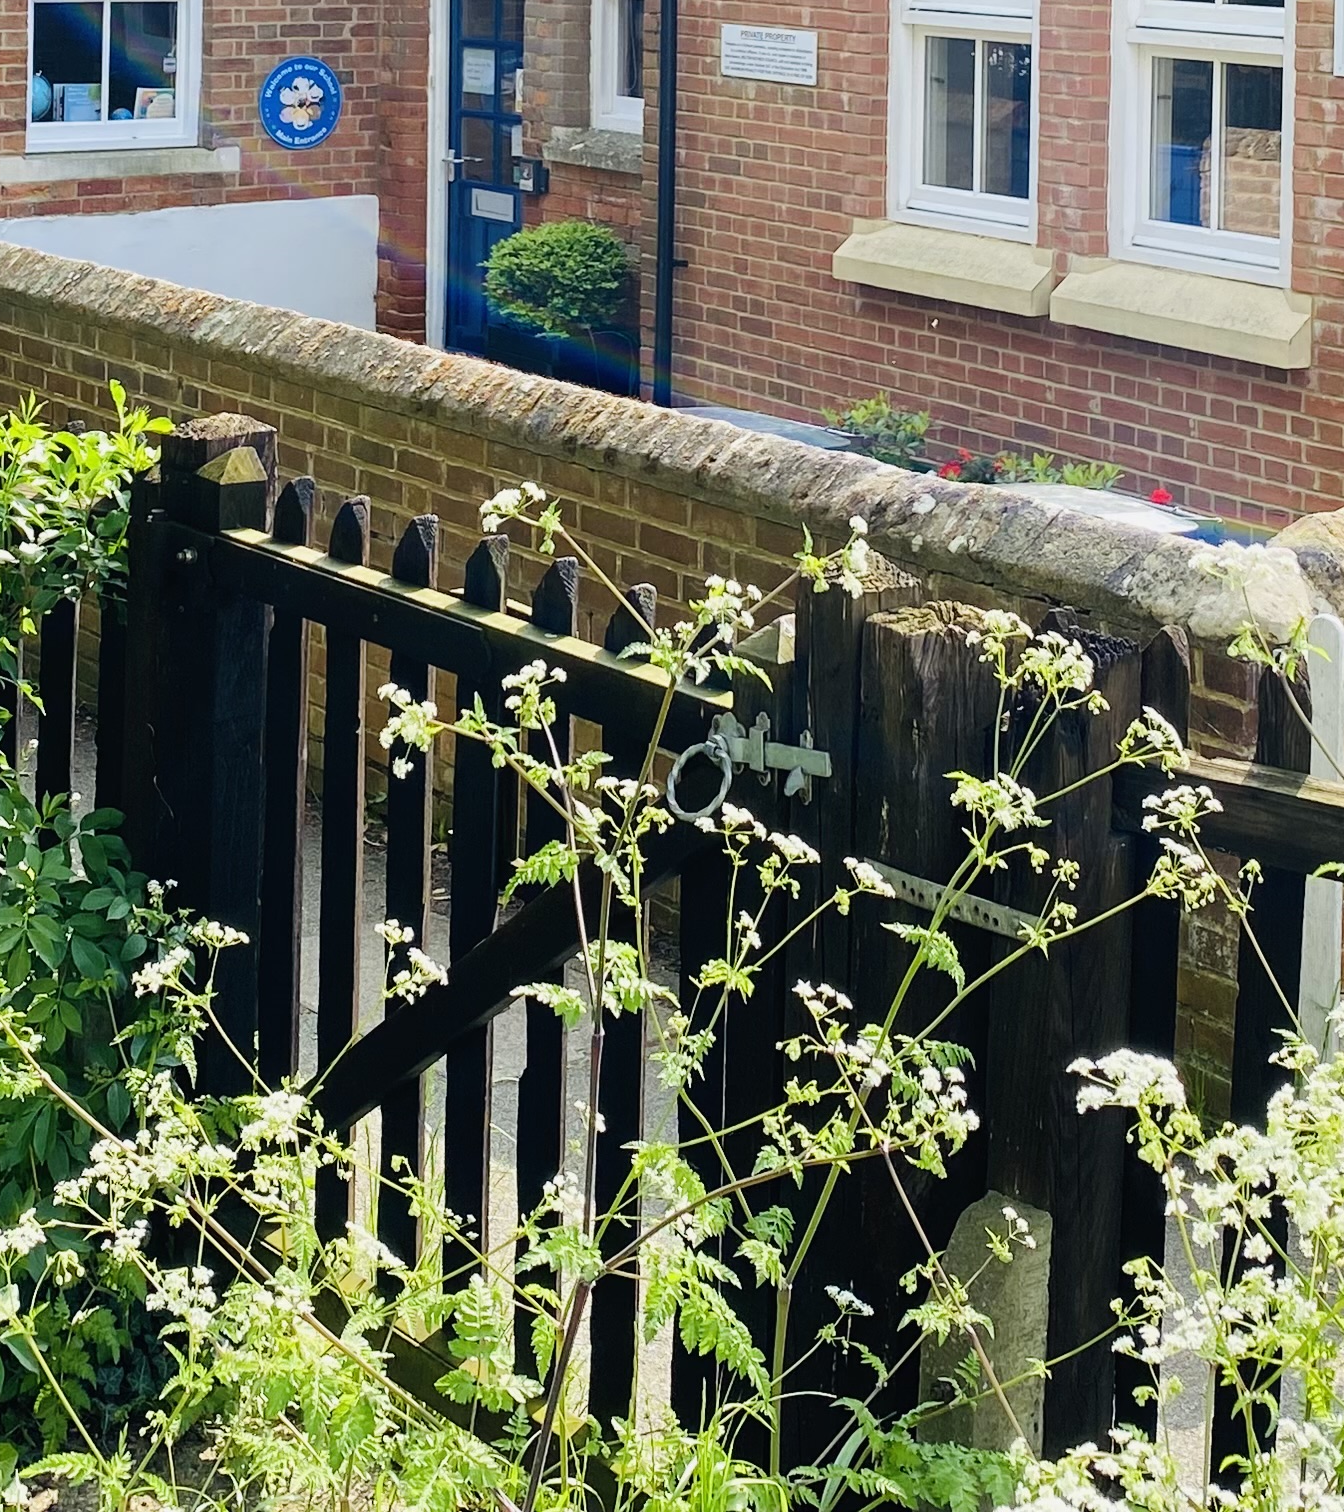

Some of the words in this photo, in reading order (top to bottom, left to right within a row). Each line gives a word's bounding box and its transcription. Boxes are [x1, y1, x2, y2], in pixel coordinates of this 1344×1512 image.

[740, 30, 763, 39] PRIVATE
[765, 32, 796, 42] PROPERTY
[265, 67, 293, 98] Welcome
[318, 68, 337, 95] School
[276, 129, 293, 144] Main
[294, 127, 327, 145] Entrance
